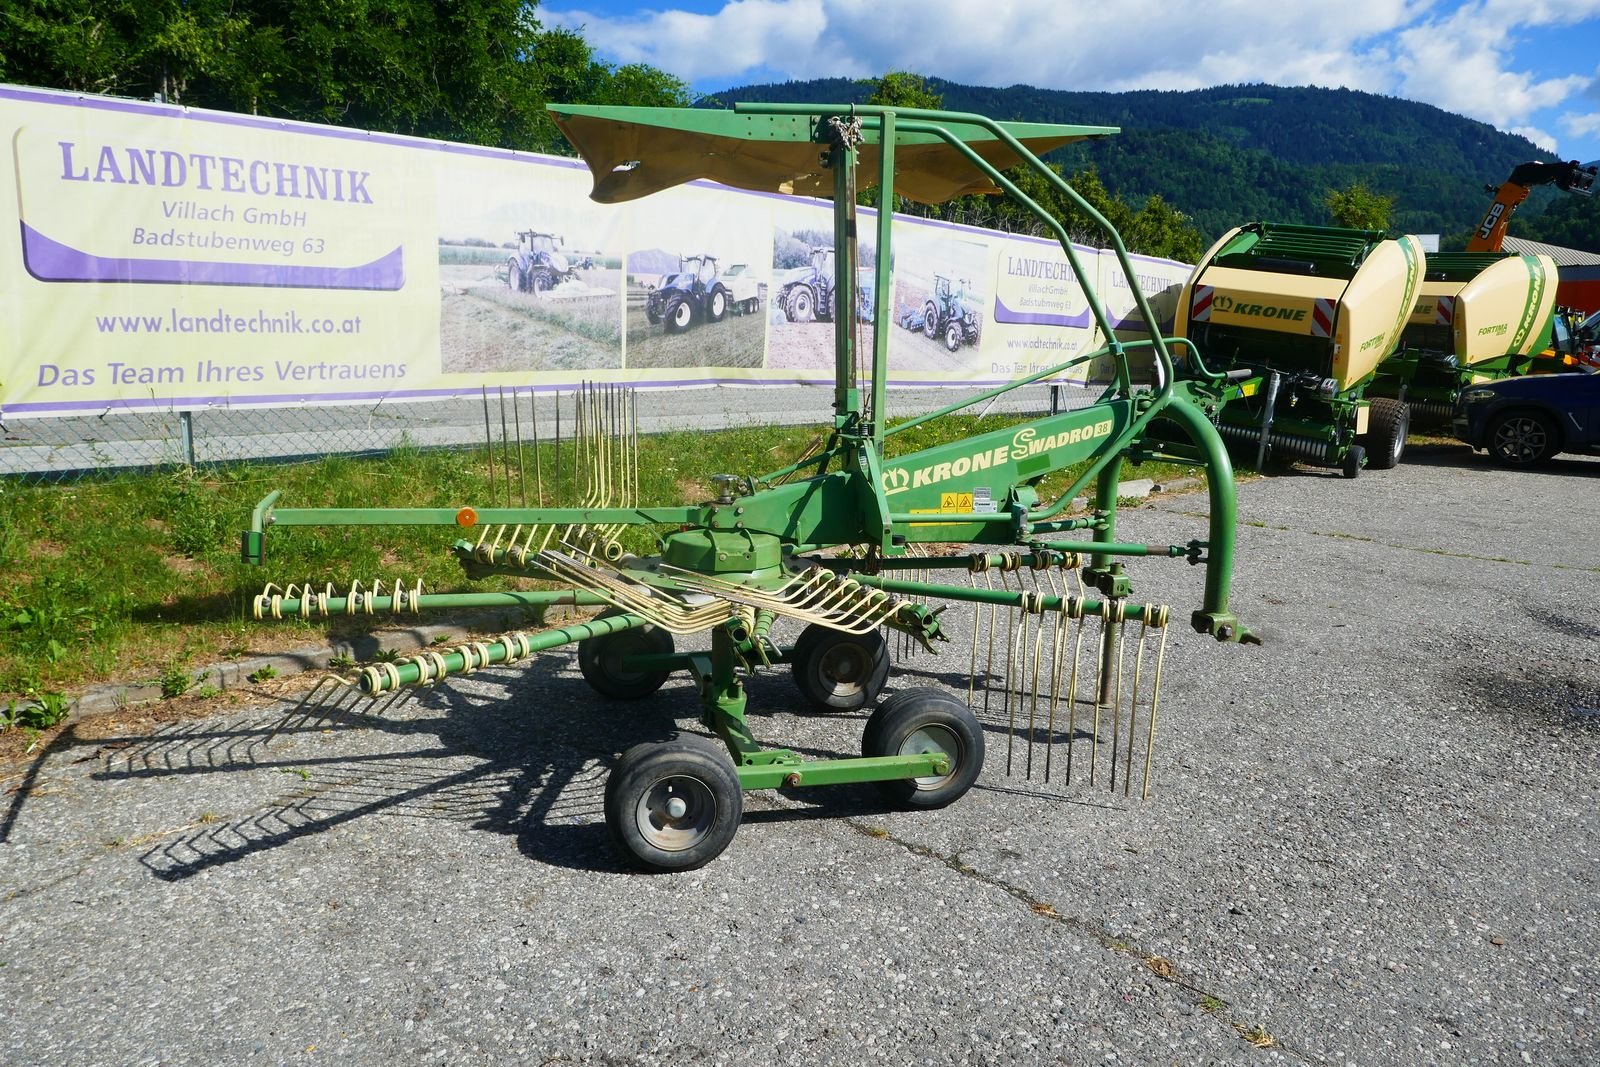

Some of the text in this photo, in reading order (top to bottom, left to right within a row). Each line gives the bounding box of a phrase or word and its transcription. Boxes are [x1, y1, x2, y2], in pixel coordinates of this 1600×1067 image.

[58, 141, 374, 205] LANDTECHNIK
[161, 200, 308, 228] Villach GmbH
[1481, 203, 1505, 239] JCB
[132, 227, 326, 257] Badstubenweg 63
[1008, 256, 1079, 283] LANDTECHN
[95, 308, 362, 335] www.landtechnik.co.at
[1233, 303, 1308, 322] KRONE
[1478, 323, 1508, 337] FORTIMA
[37, 359, 408, 388] Das Team Ihres Vertrauens
[991, 362, 1011, 374] Das
[912, 422, 1108, 489] KRONE SWADRO 38
